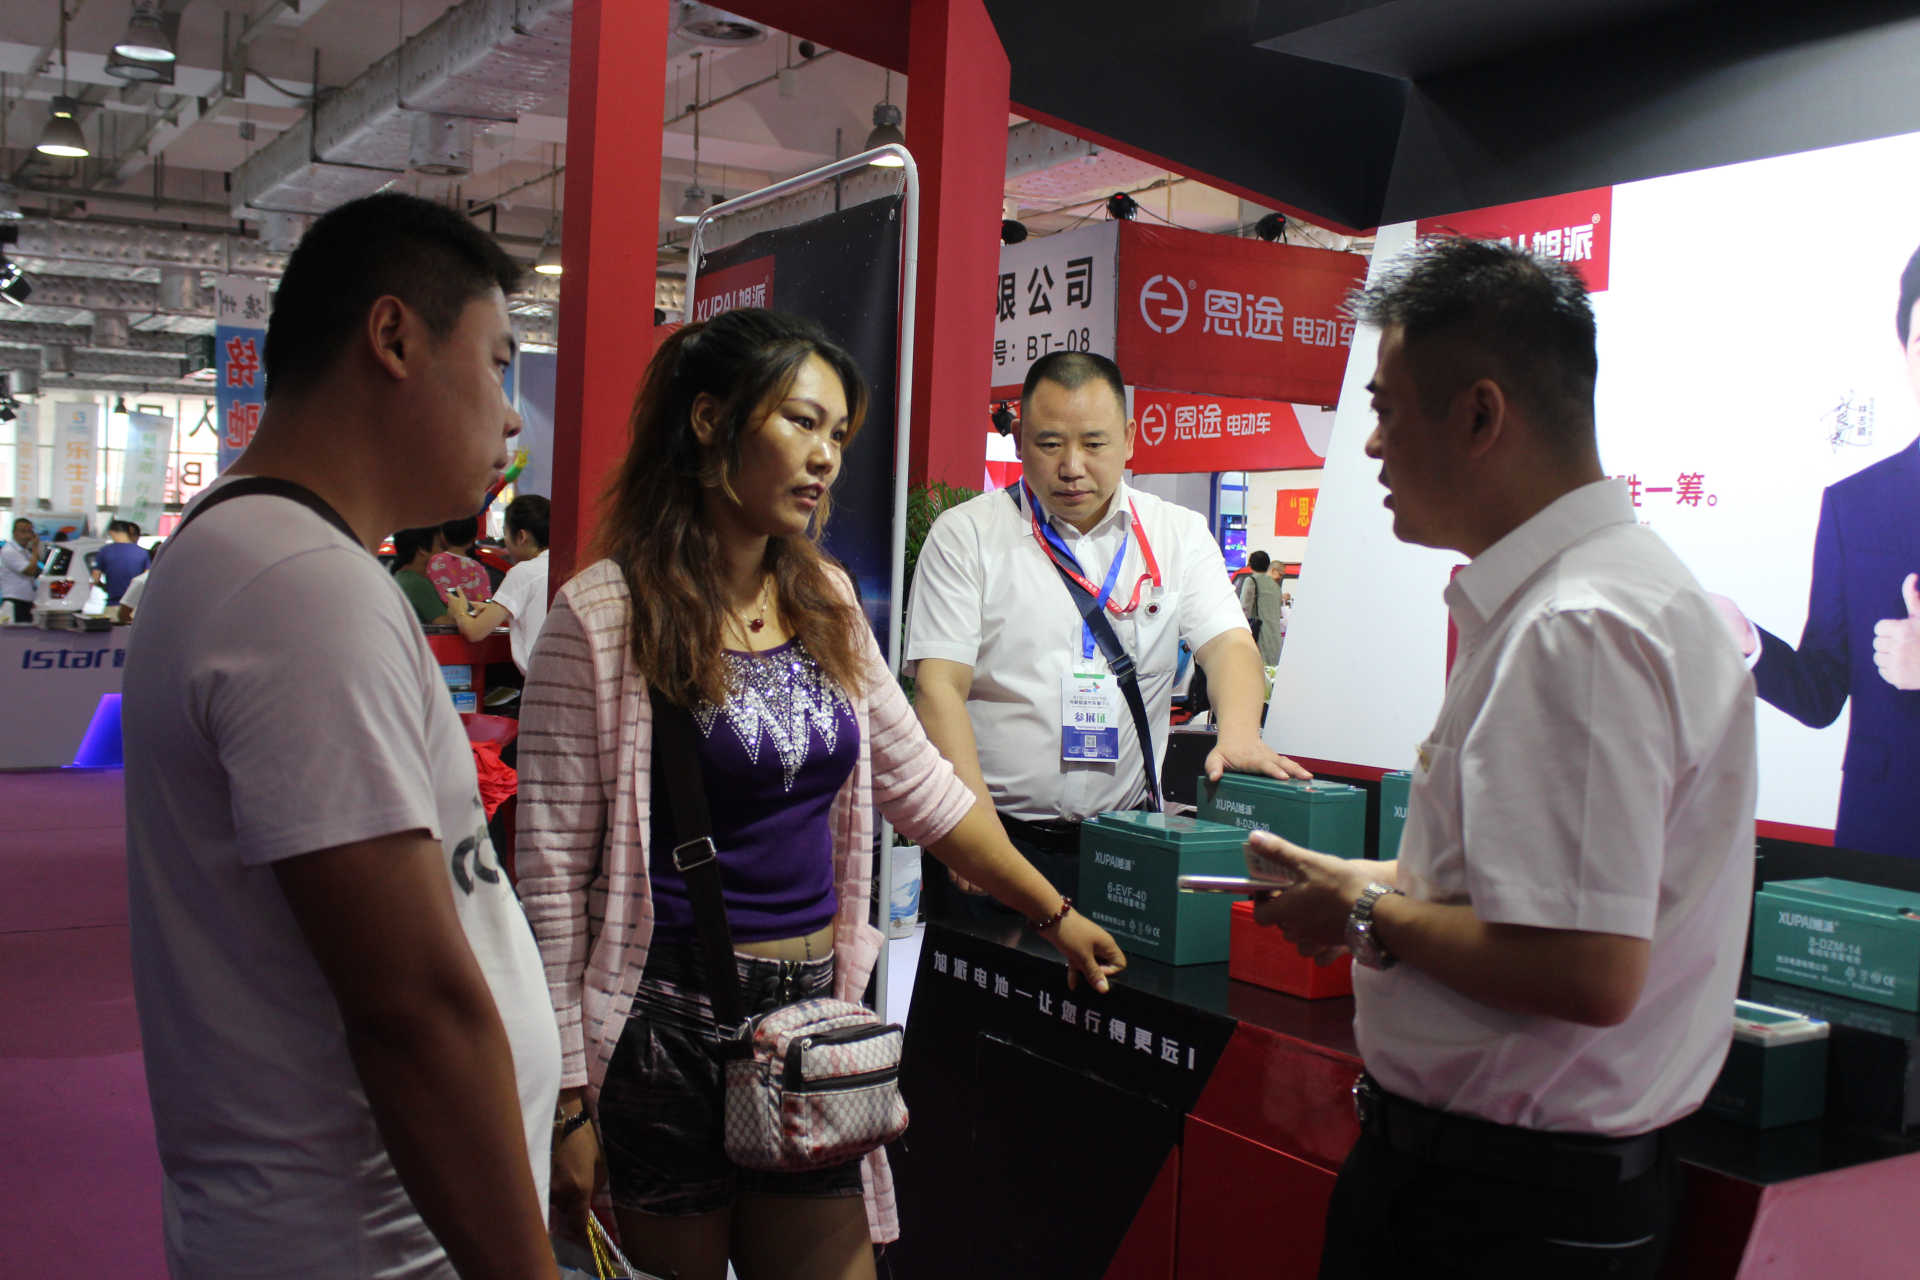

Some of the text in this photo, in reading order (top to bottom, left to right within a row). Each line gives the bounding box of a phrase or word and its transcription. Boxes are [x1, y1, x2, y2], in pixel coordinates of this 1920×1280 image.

[1203, 289, 1284, 342] 恩途
[1174, 404, 1271, 440] 恩途 电动车
